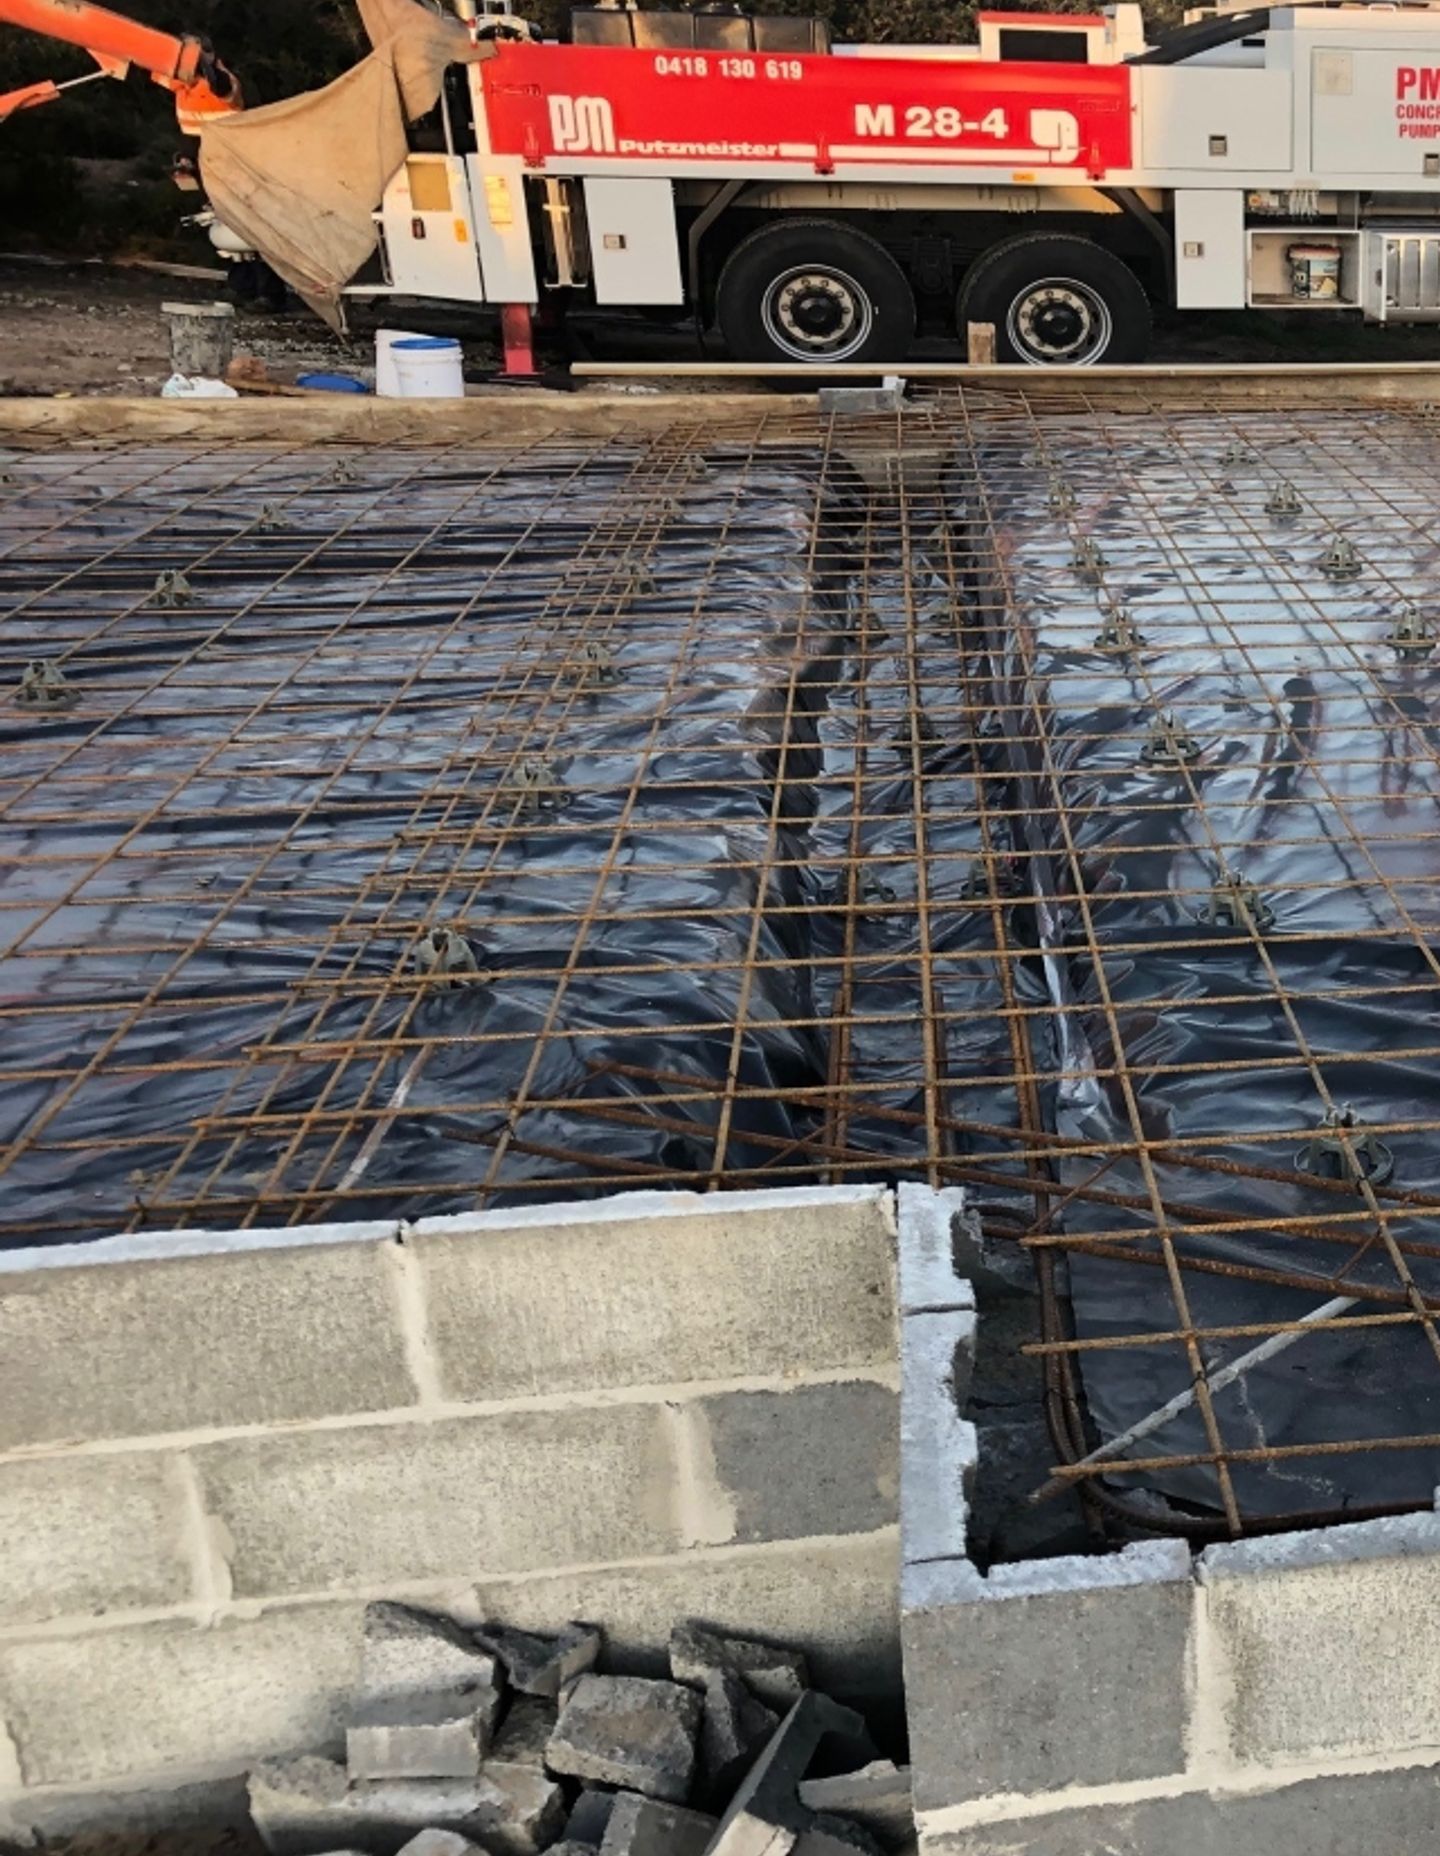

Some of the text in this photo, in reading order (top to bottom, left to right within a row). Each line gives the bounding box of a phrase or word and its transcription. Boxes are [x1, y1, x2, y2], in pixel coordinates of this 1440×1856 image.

[655, 55, 802, 80] 0418 130 619
[855, 104, 1009, 139] M 28-4
[619, 139, 778, 157] Putzmeister
